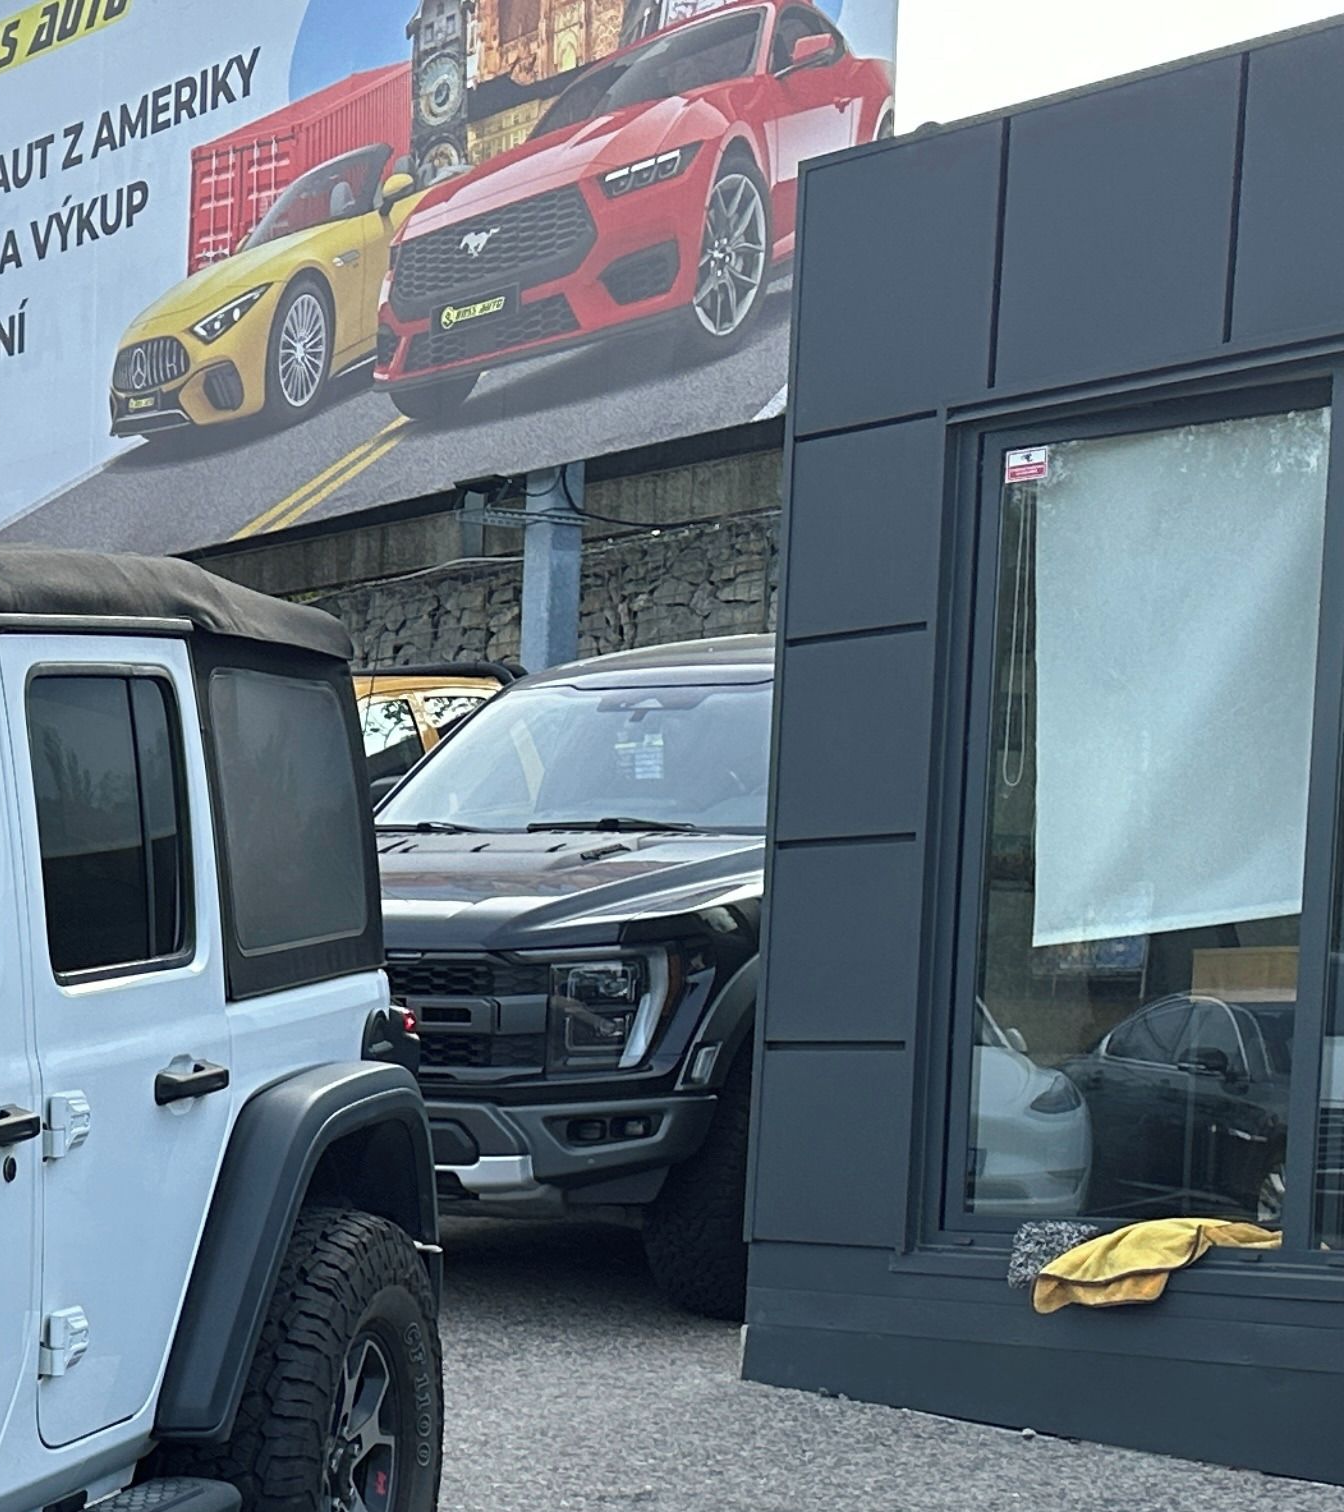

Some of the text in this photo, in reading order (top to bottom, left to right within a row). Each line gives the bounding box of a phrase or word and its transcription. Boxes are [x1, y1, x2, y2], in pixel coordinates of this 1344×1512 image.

[61, 121, 84, 171] Z
[90, 46, 261, 159] AMERIKY
[30, 180, 149, 260] VÝKUP
